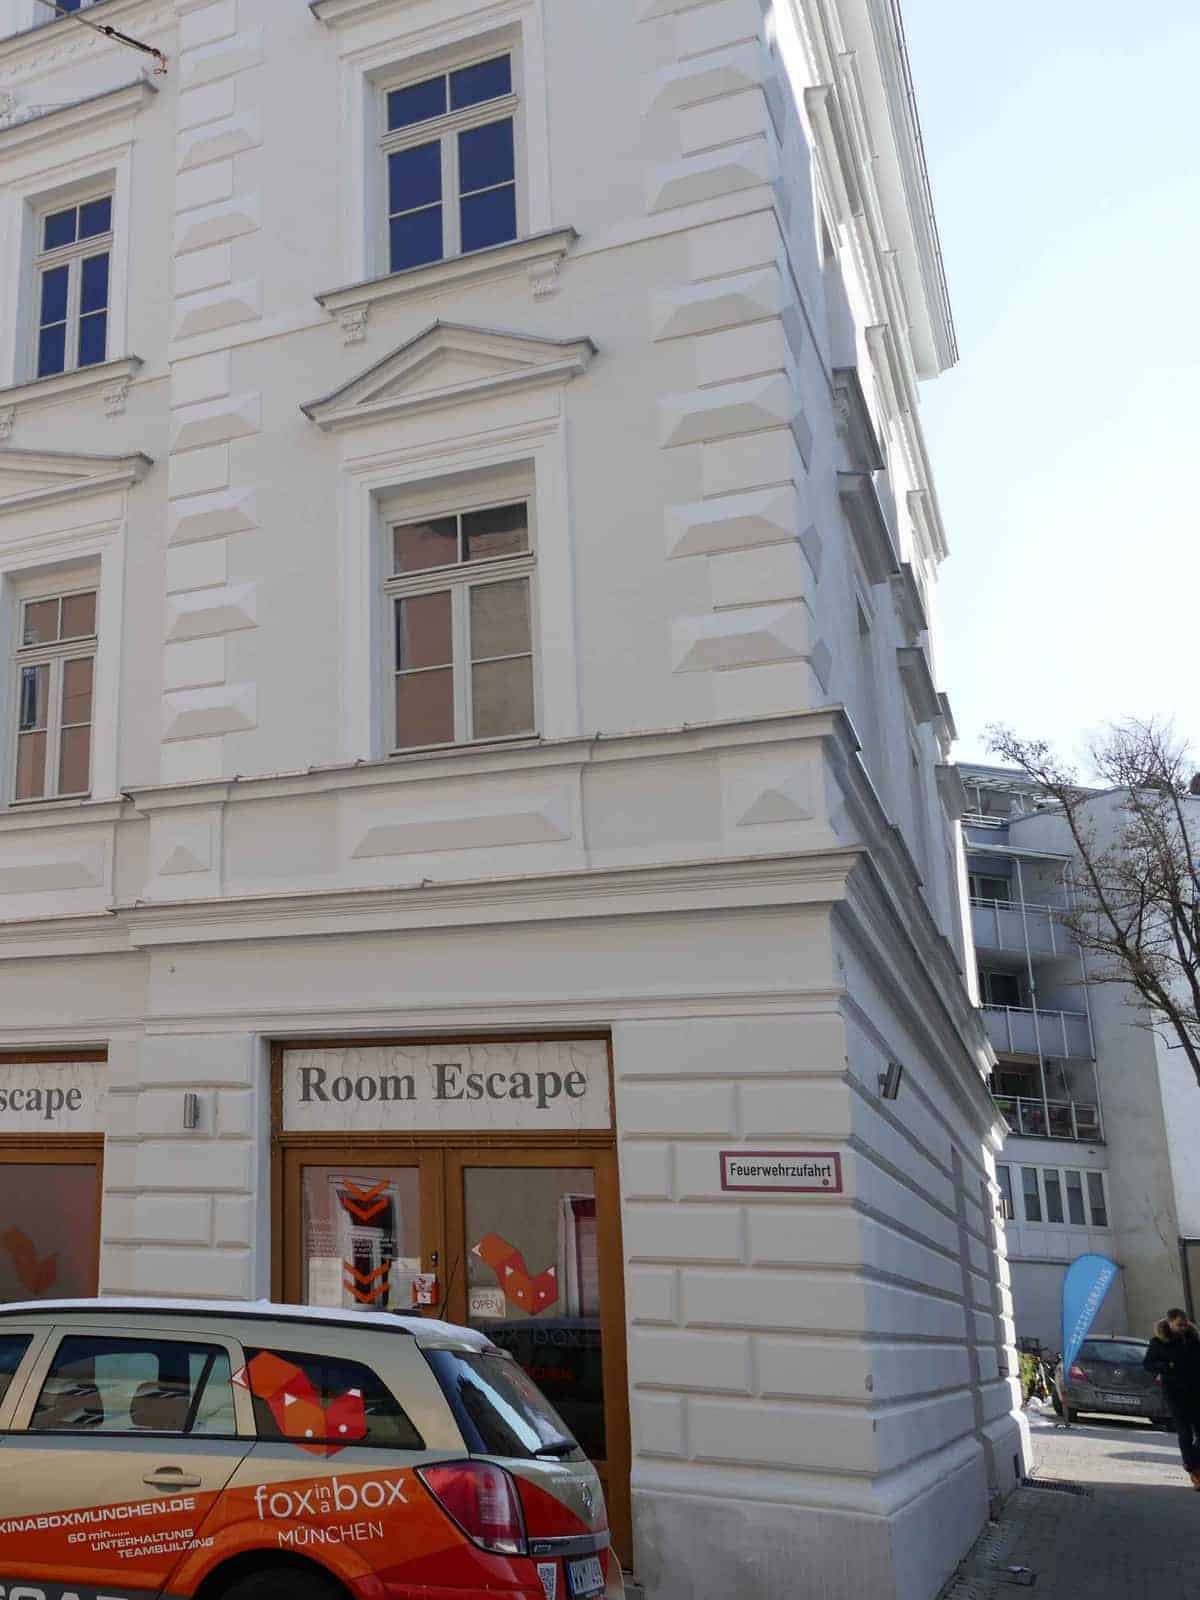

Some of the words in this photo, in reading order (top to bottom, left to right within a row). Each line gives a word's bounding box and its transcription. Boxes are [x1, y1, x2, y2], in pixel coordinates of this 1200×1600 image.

[298, 1066, 417, 1102] Room
[432, 1063, 587, 1109] Escape
[730, 1162, 832, 1177] Feuerwehrzufahrt
[254, 1485, 316, 1521] fox
[331, 1476, 409, 1512] box
[67, 1532, 87, 1544] 60
[91, 1528, 194, 1552] UNTERHALTUNG
[278, 1521, 384, 1548] MÜNCHEN
[119, 1537, 214, 1559] TEAMBUILDING
